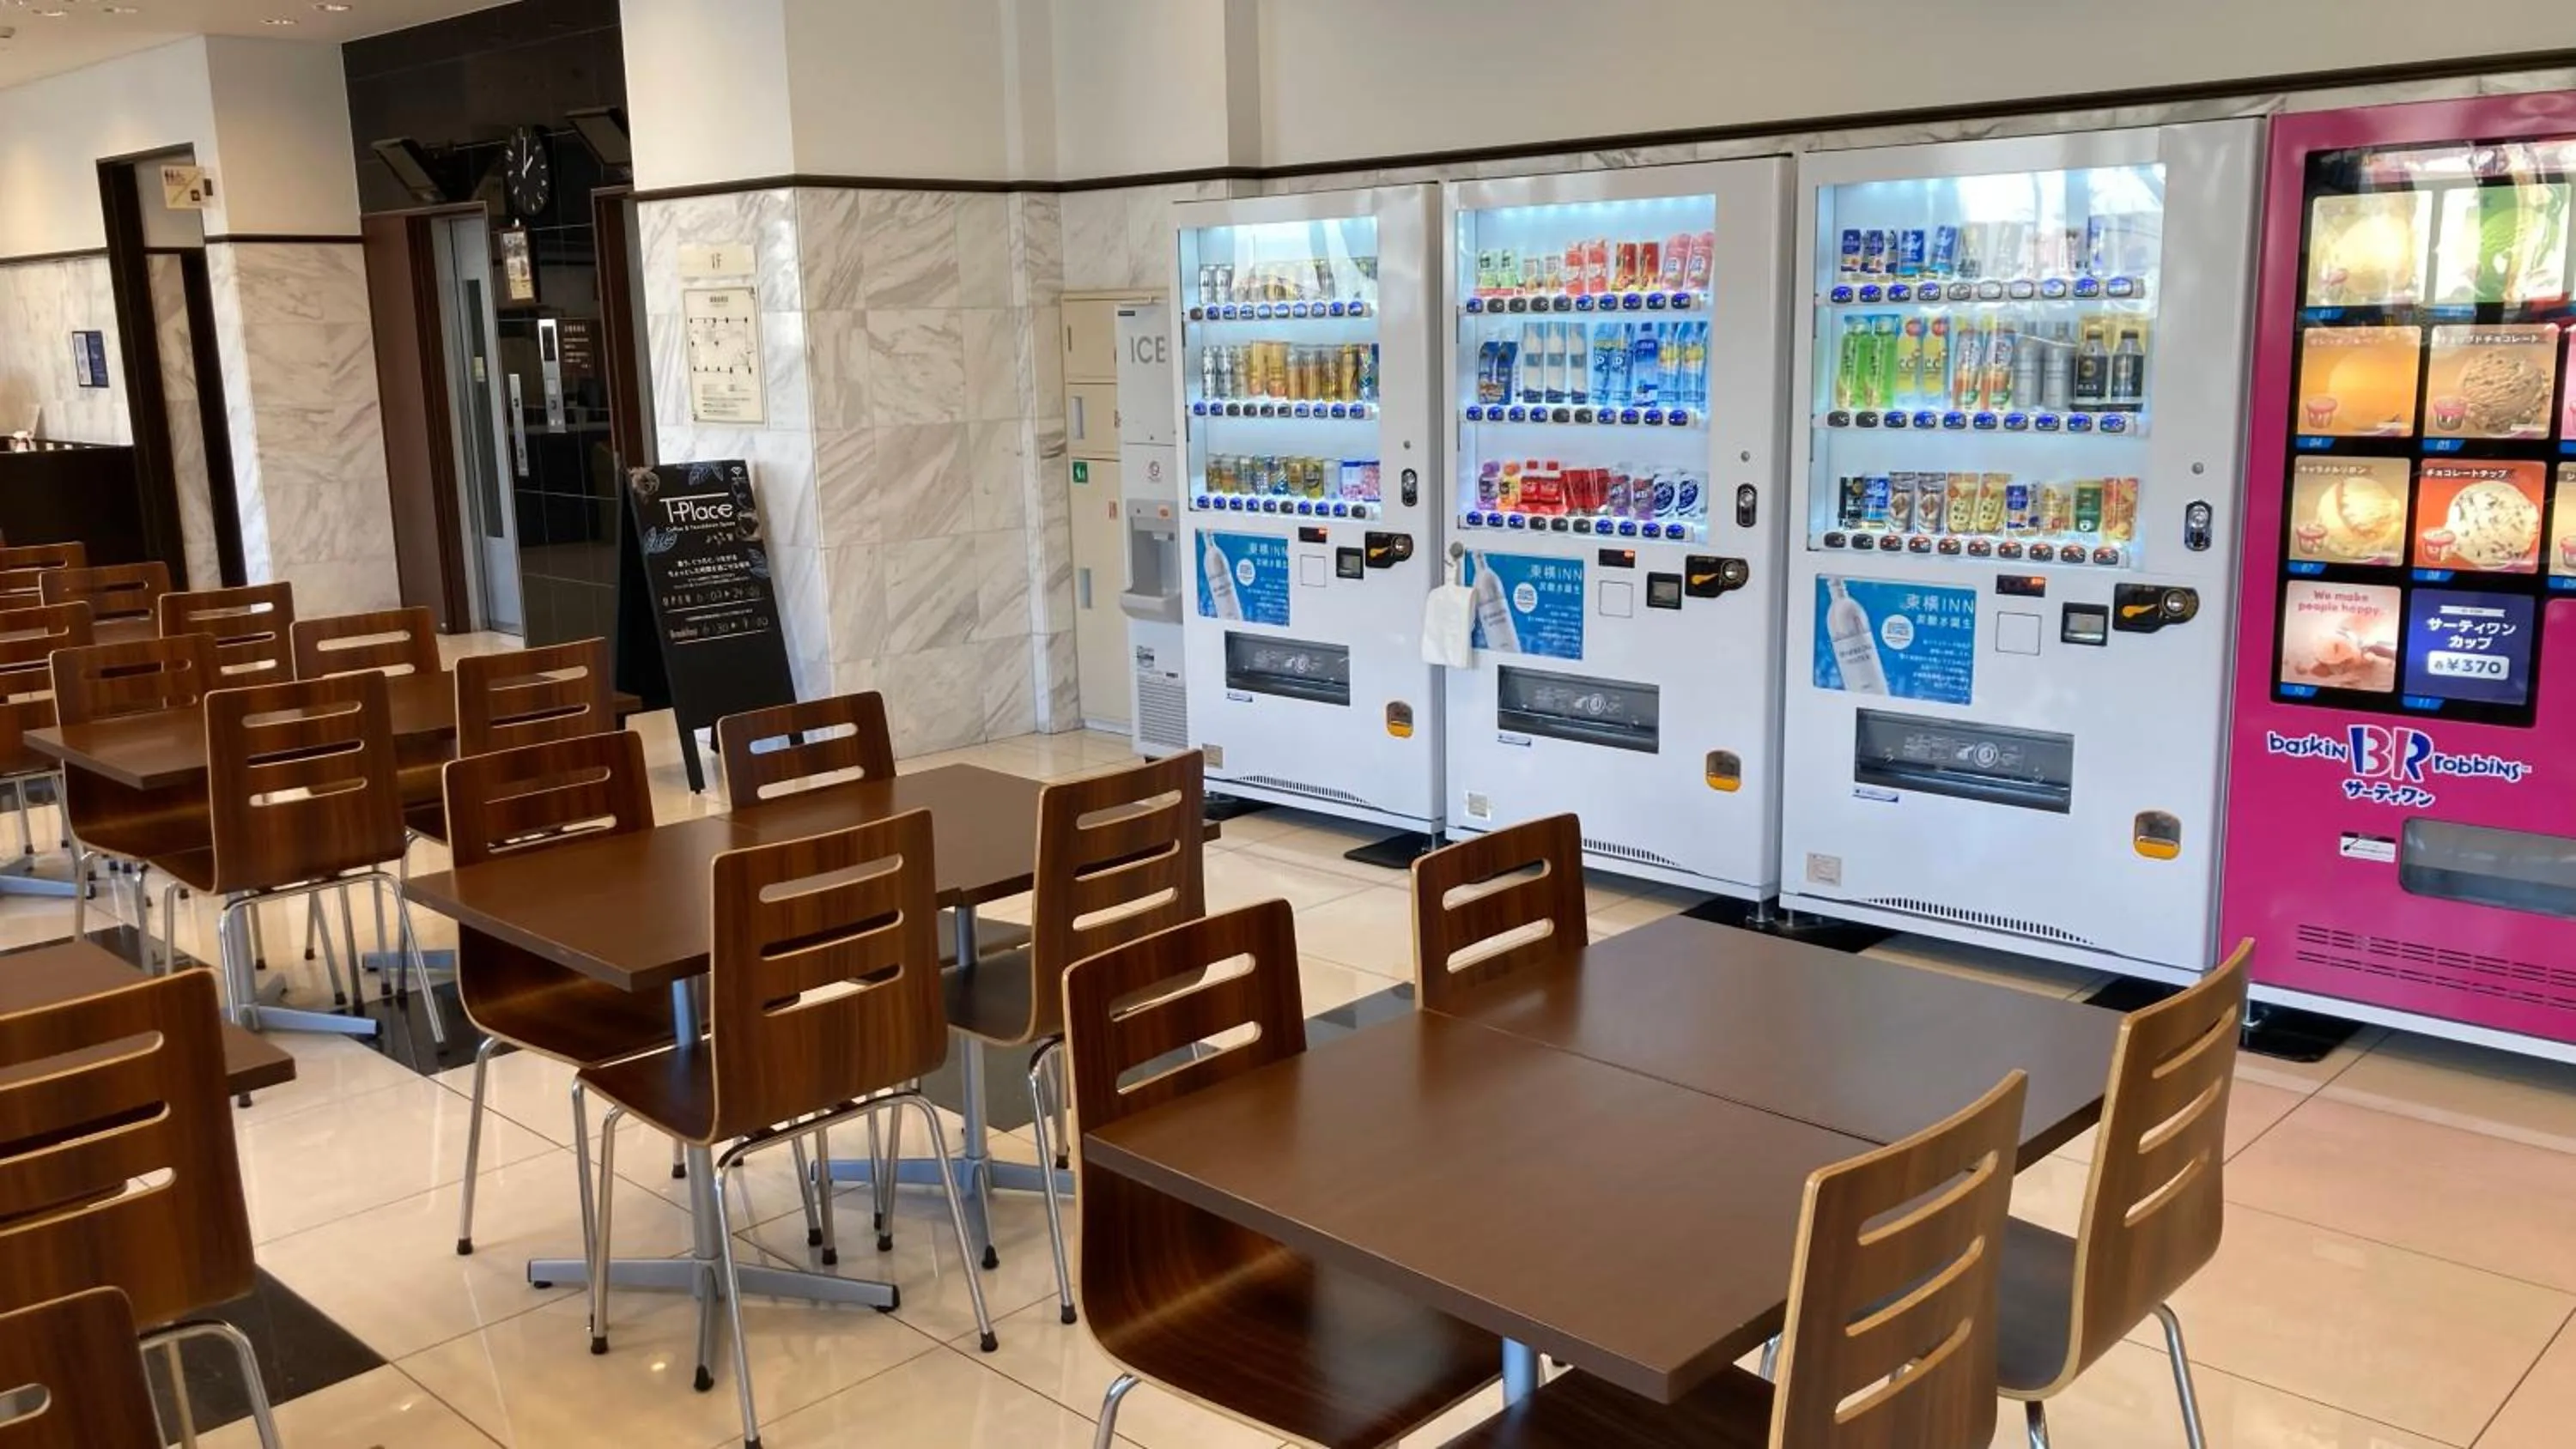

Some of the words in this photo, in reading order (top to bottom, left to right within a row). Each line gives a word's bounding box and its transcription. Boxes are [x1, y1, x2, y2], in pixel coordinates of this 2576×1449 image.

[1131, 336, 1167, 364] ICE
[1529, 564, 1583, 582] 東横INN
[1905, 593, 1974, 615] 東横INN
[2427, 617, 2518, 636] サーティワン
[2447, 635, 2494, 650] カップ
[2268, 731, 2348, 761] baskin
[2348, 724, 2433, 782] BR
[2433, 754, 2523, 781] robbins
[2343, 779, 2435, 807] サーティワン
